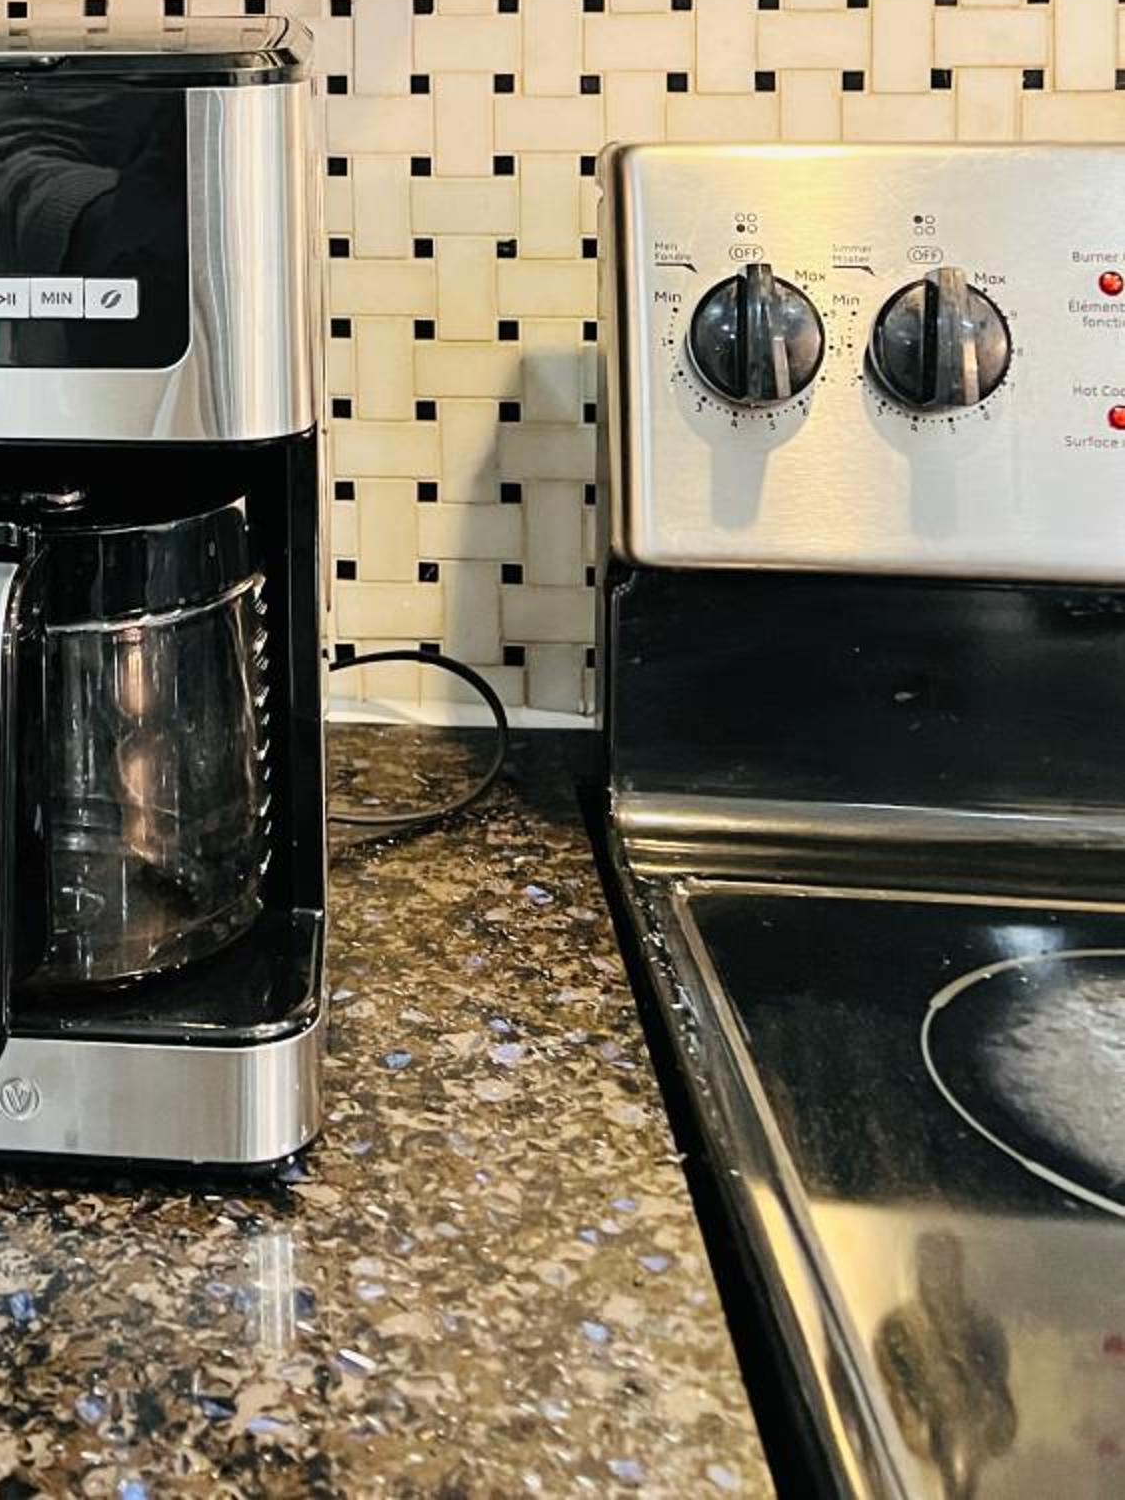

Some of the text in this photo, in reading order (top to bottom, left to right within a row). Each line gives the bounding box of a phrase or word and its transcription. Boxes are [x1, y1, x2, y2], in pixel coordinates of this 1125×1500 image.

[735, 248, 759, 258] OFF
[913, 250, 939, 261] OFF
[1072, 251, 1118, 263] Burner
[795, 270, 826, 282] Max
[974, 273, 1006, 285] Max
[41, 291, 72, 305] MIN
[654, 292, 682, 303] Min
[832, 295, 860, 306] Min
[1073, 384, 1098, 397] Hot
[1063, 435, 1119, 448] Surface
